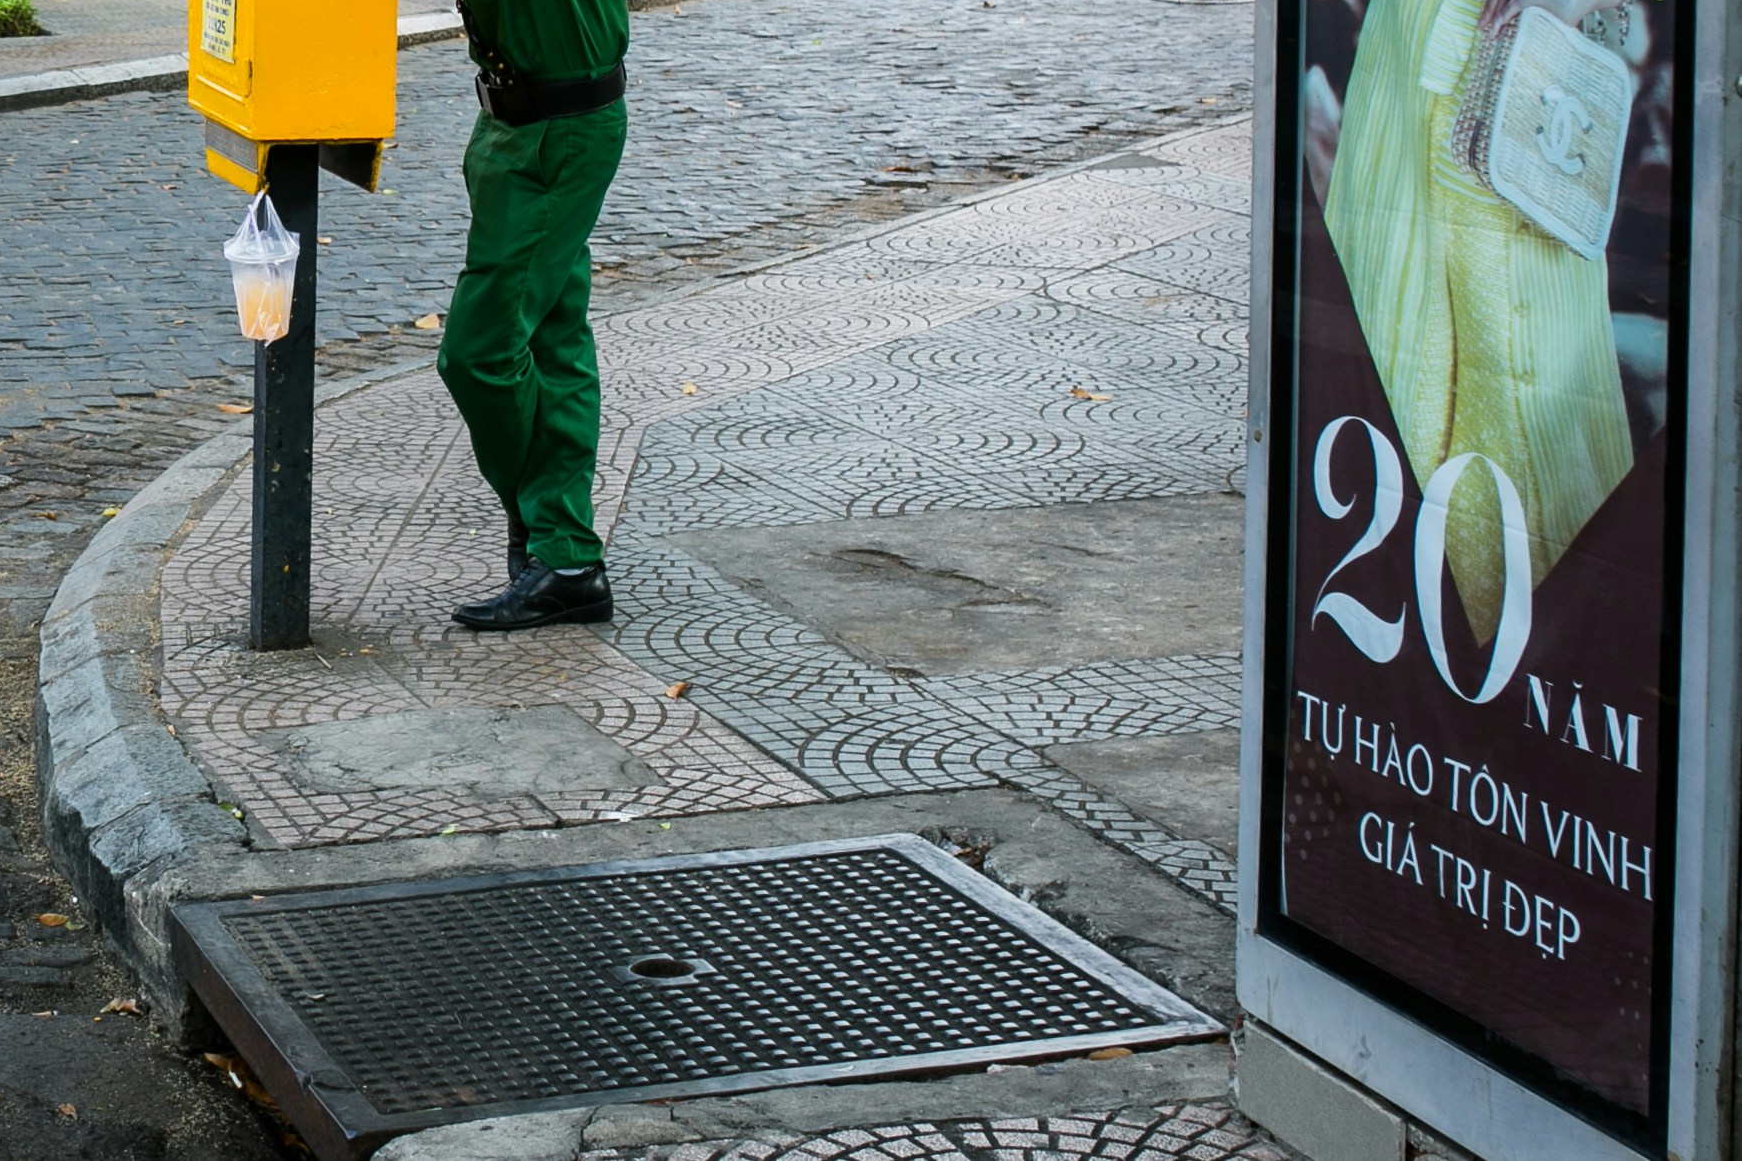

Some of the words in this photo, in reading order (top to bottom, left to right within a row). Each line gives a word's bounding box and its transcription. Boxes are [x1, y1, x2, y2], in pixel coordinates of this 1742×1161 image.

[1311, 415, 1533, 705] 20
[1524, 673, 1644, 772] NĂM
[1297, 690, 1348, 755] TỰ
[1354, 715, 1434, 797] HÀO
[1444, 757, 1528, 842] TÔN
[1540, 801, 1653, 901] VINH
[1359, 812, 1423, 886] GIÁ
[1430, 844, 1490, 930] TRỊ
[1502, 879, 1581, 960] ĐẸP
